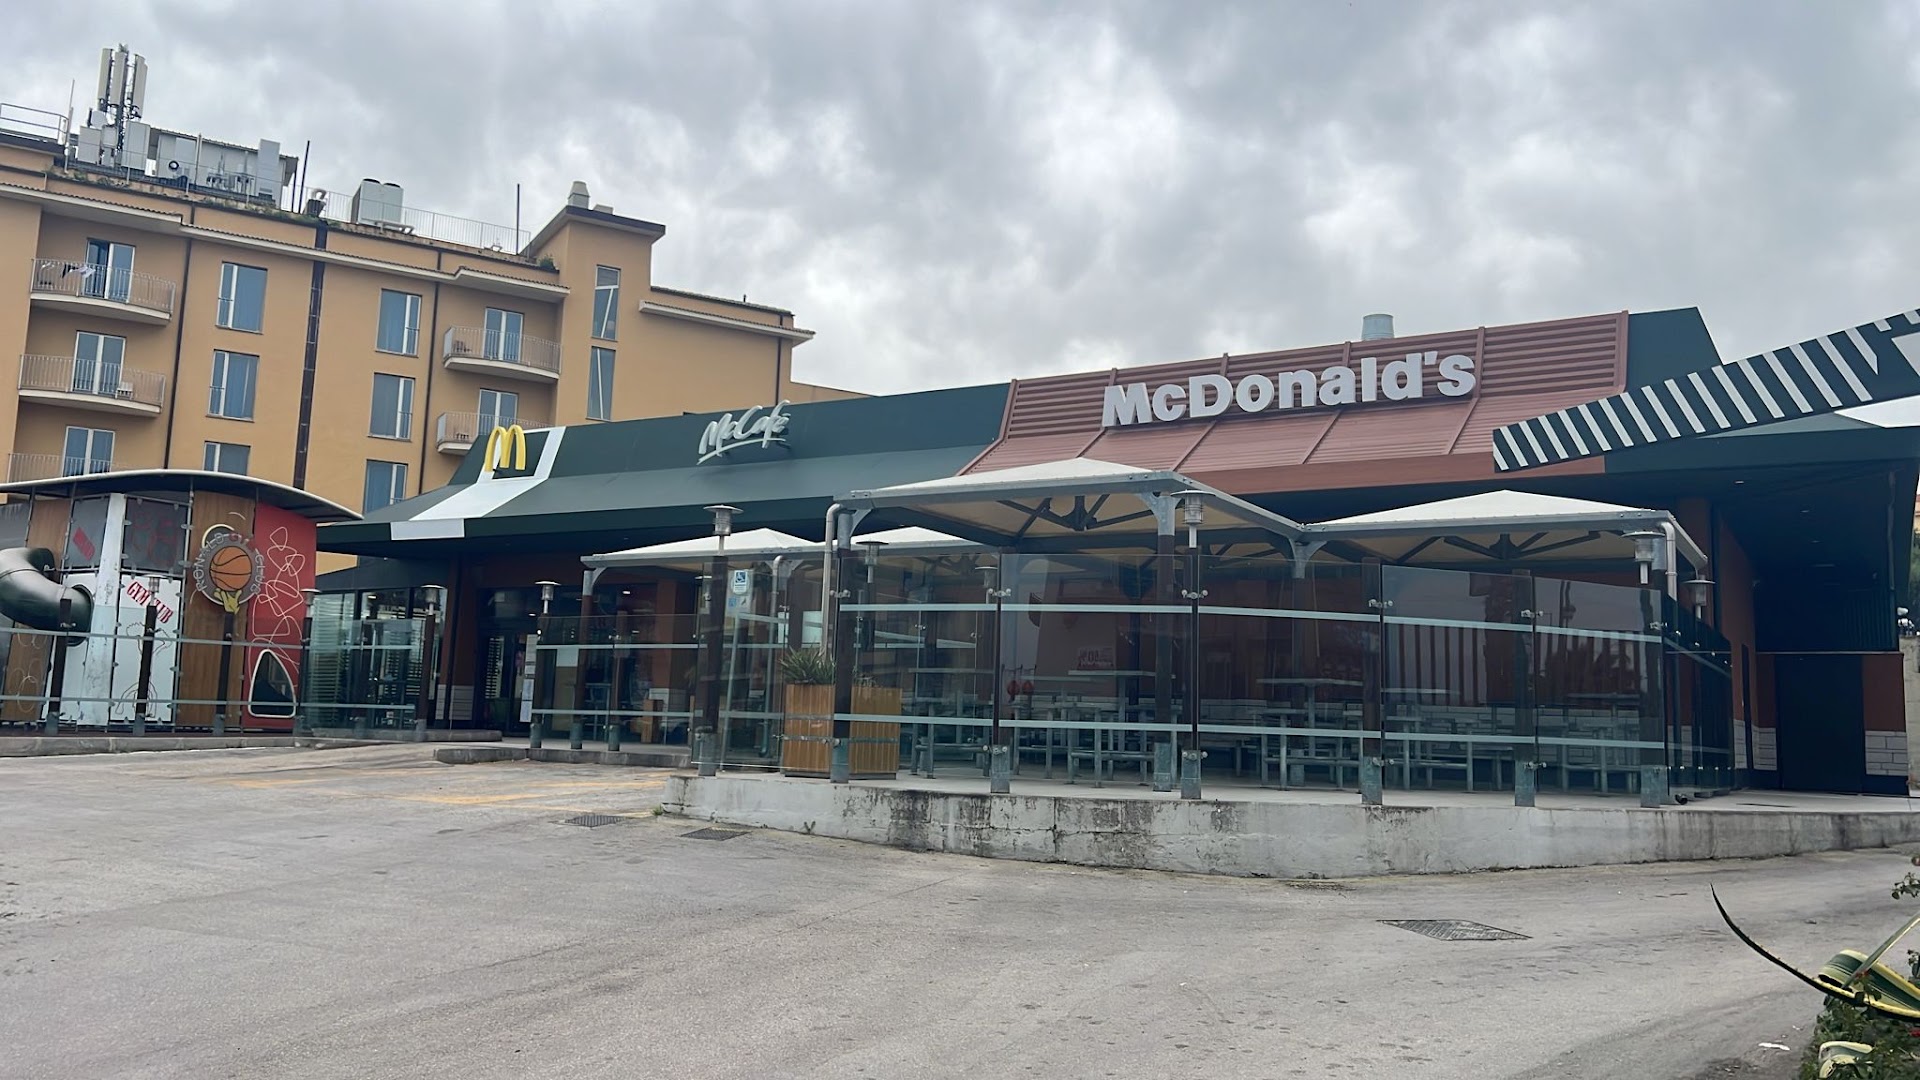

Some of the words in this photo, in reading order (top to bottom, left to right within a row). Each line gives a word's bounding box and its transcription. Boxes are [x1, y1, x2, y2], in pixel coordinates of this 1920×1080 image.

[1102, 351, 1477, 427] McDonald's
[250, 553, 266, 595] CLUB
[126, 581, 151, 606] GYM
[153, 597, 174, 624] UB
